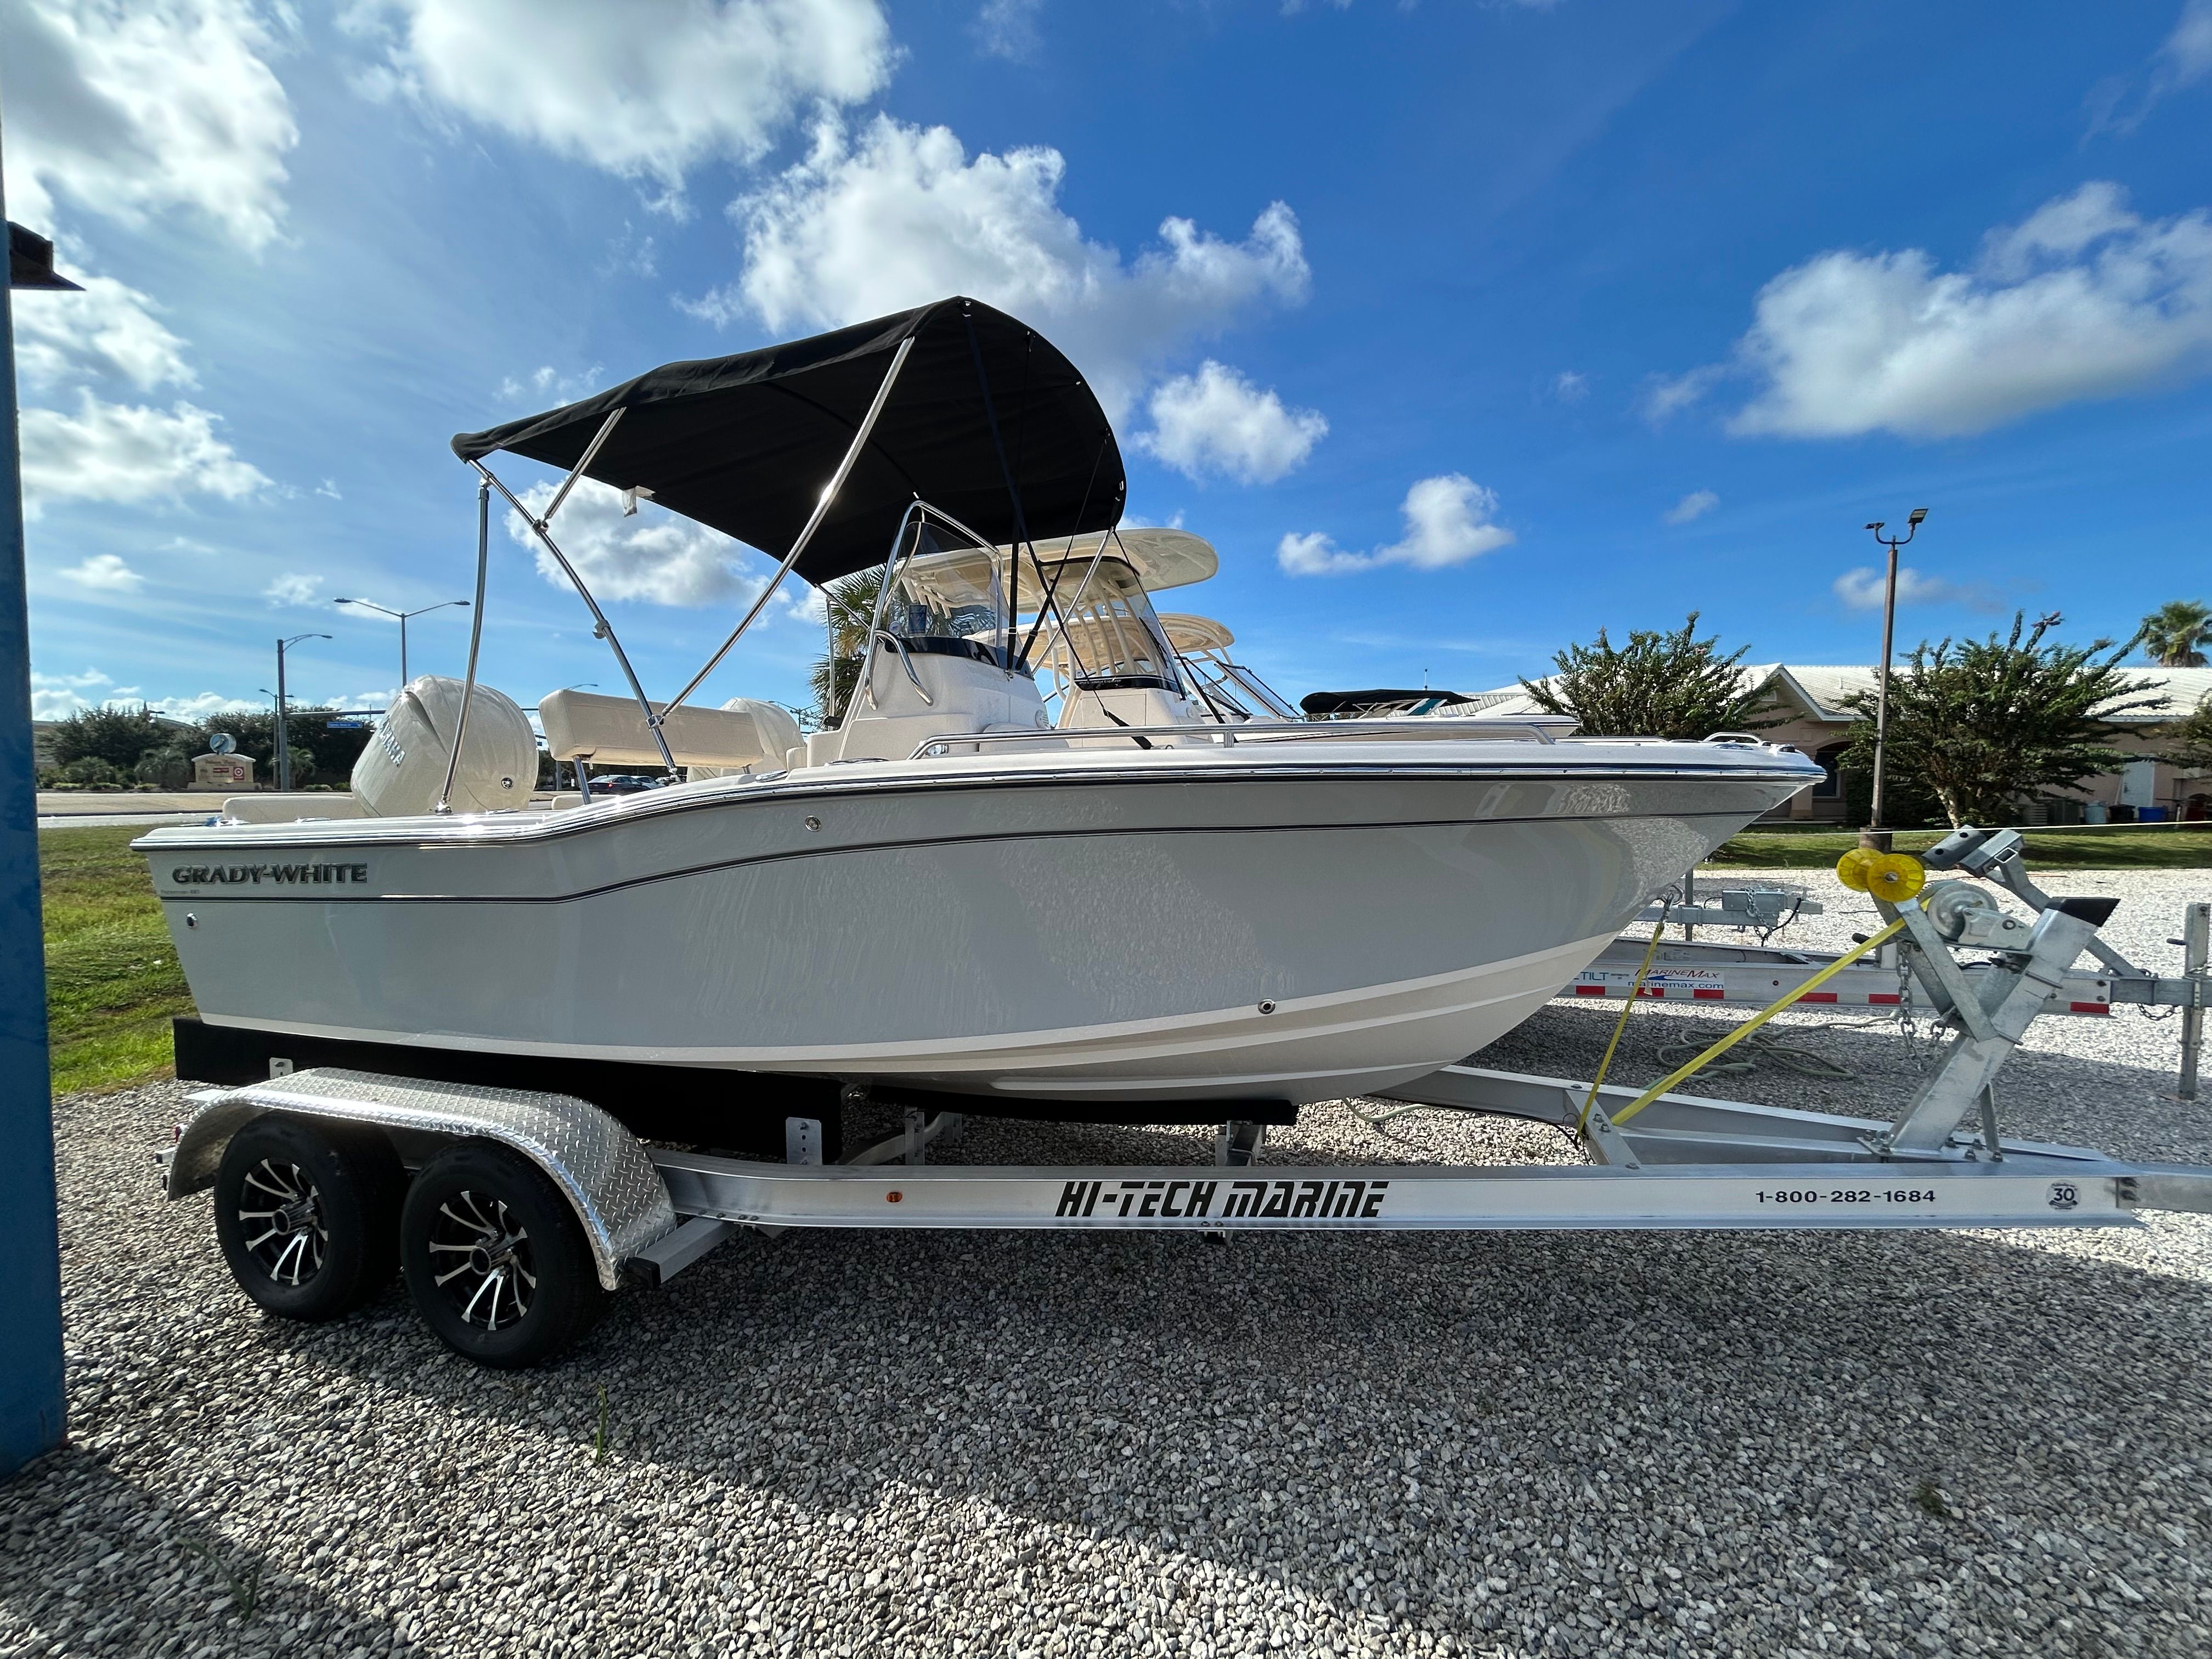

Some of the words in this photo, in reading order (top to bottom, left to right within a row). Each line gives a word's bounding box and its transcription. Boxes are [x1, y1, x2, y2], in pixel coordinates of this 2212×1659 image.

[379, 714, 405, 767] AMAHA
[172, 862, 368, 884] GRADY-WHITE
[1573, 972, 1609, 980] TILT
[1628, 980, 1724, 989] mainemax.com
[1055, 1181, 1218, 1217] HI-TECH
[1221, 1181, 1390, 1217] MARINE
[1756, 1190, 1936, 1203] 1-800-282-1684
[2053, 1188, 2075, 1201] 30
